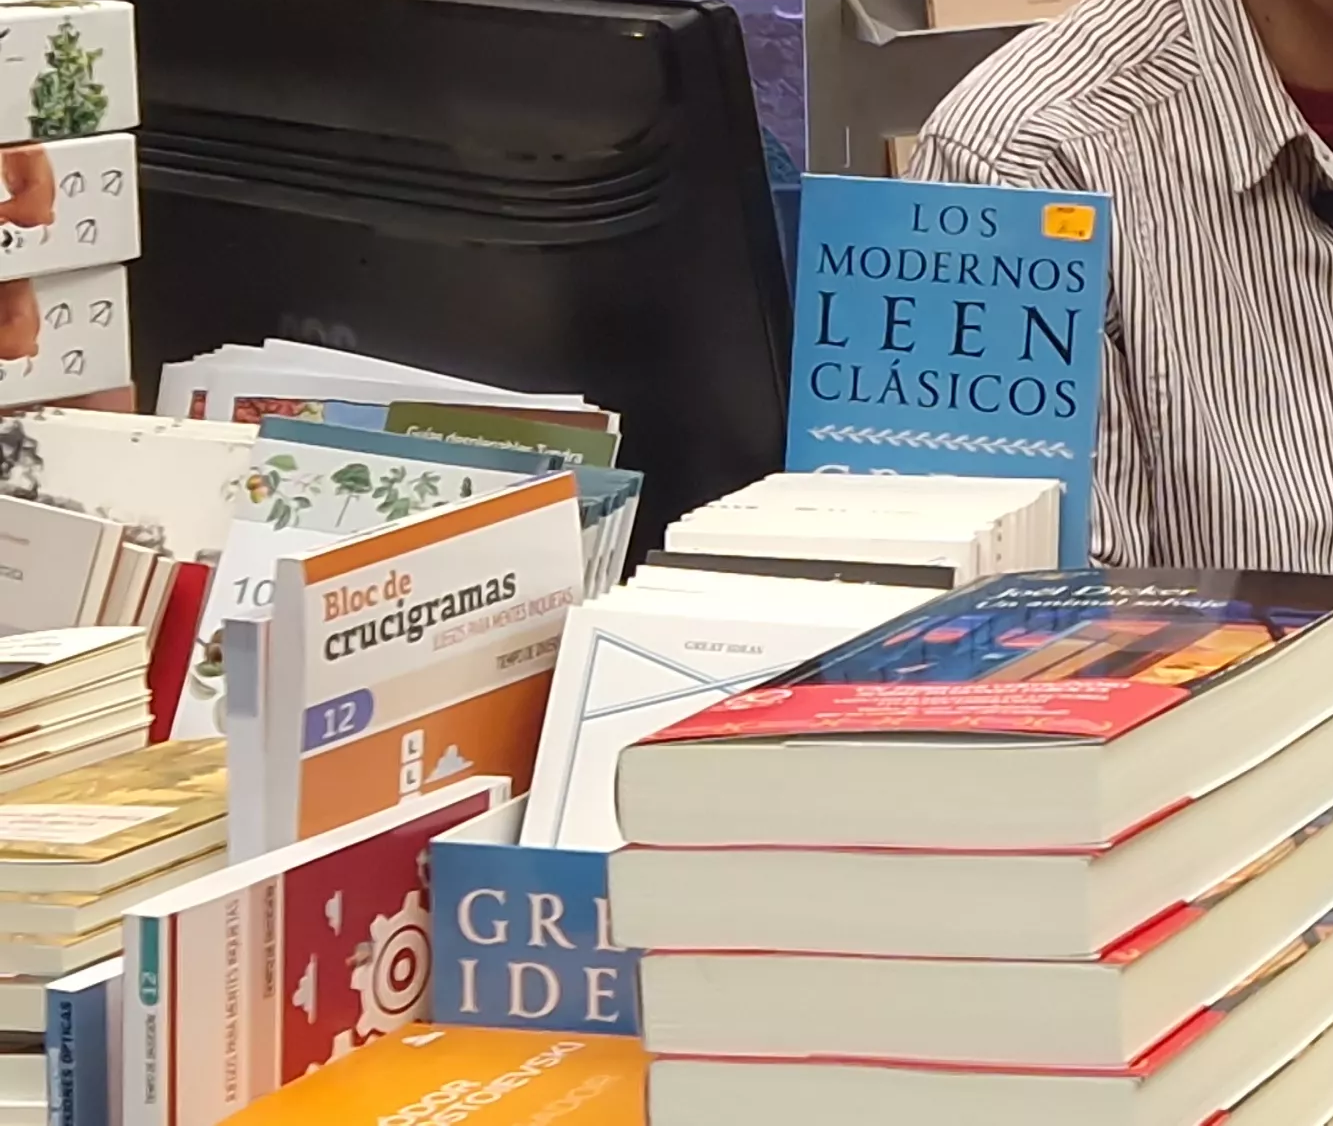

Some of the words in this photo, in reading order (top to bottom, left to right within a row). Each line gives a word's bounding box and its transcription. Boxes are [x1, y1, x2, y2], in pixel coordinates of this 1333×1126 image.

[911, 203, 998, 238] LOS
[816, 243, 1086, 294] MODERNOS
[814, 290, 1082, 366] LEEN
[810, 358, 1077, 418] CLÁSICOS
[322, 585, 378, 623] Bloc
[383, 569, 413, 600] de
[991, 585, 1063, 600] Joël
[1071, 585, 1198, 597] Dicker
[324, 572, 517, 662] crucigramas
[321, 701, 357, 740] 12
[407, 740, 418, 755] L
[406, 769, 417, 785] L
[141, 972, 158, 995] 12
[457, 958, 620, 1023] IDE
